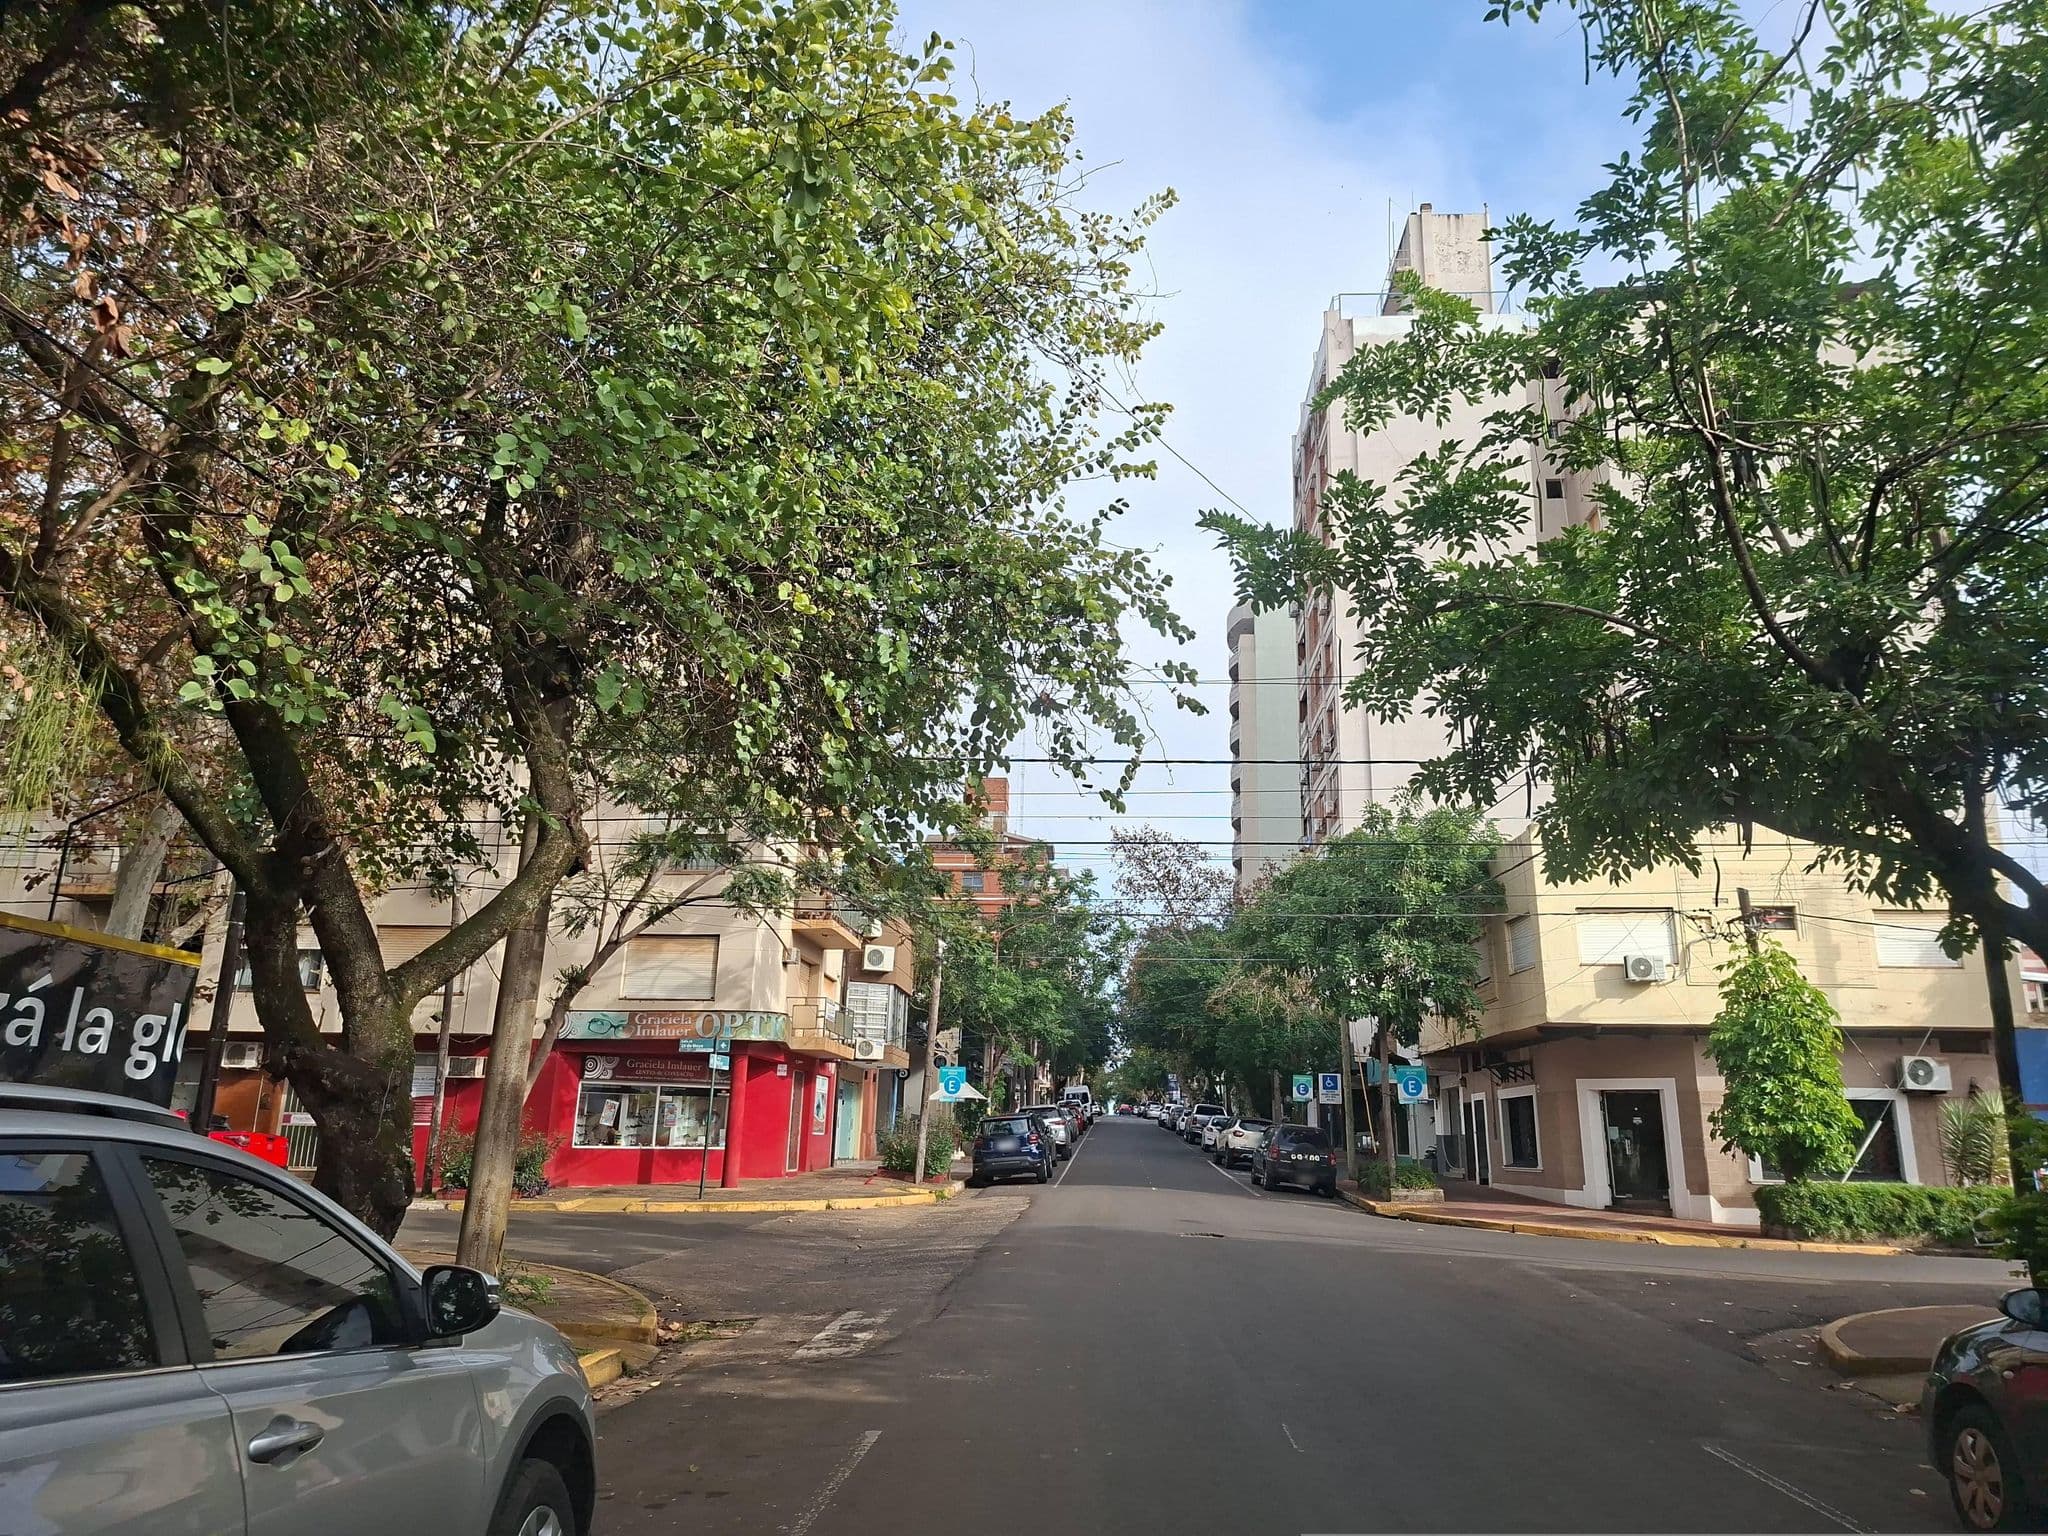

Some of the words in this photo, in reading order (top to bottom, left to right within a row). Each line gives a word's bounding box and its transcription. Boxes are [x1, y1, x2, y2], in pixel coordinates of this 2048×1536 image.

[0, 973, 53, 1047] á
[61, 986, 114, 1055] la
[634, 1012, 692, 1025] Graciela
[634, 1025, 691, 1038] Imlauer
[626, 1058, 665, 1069] Graciela
[667, 1059, 702, 1071] Imlauer
[948, 1080, 956, 1092] E
[1408, 1080, 1417, 1093] E
